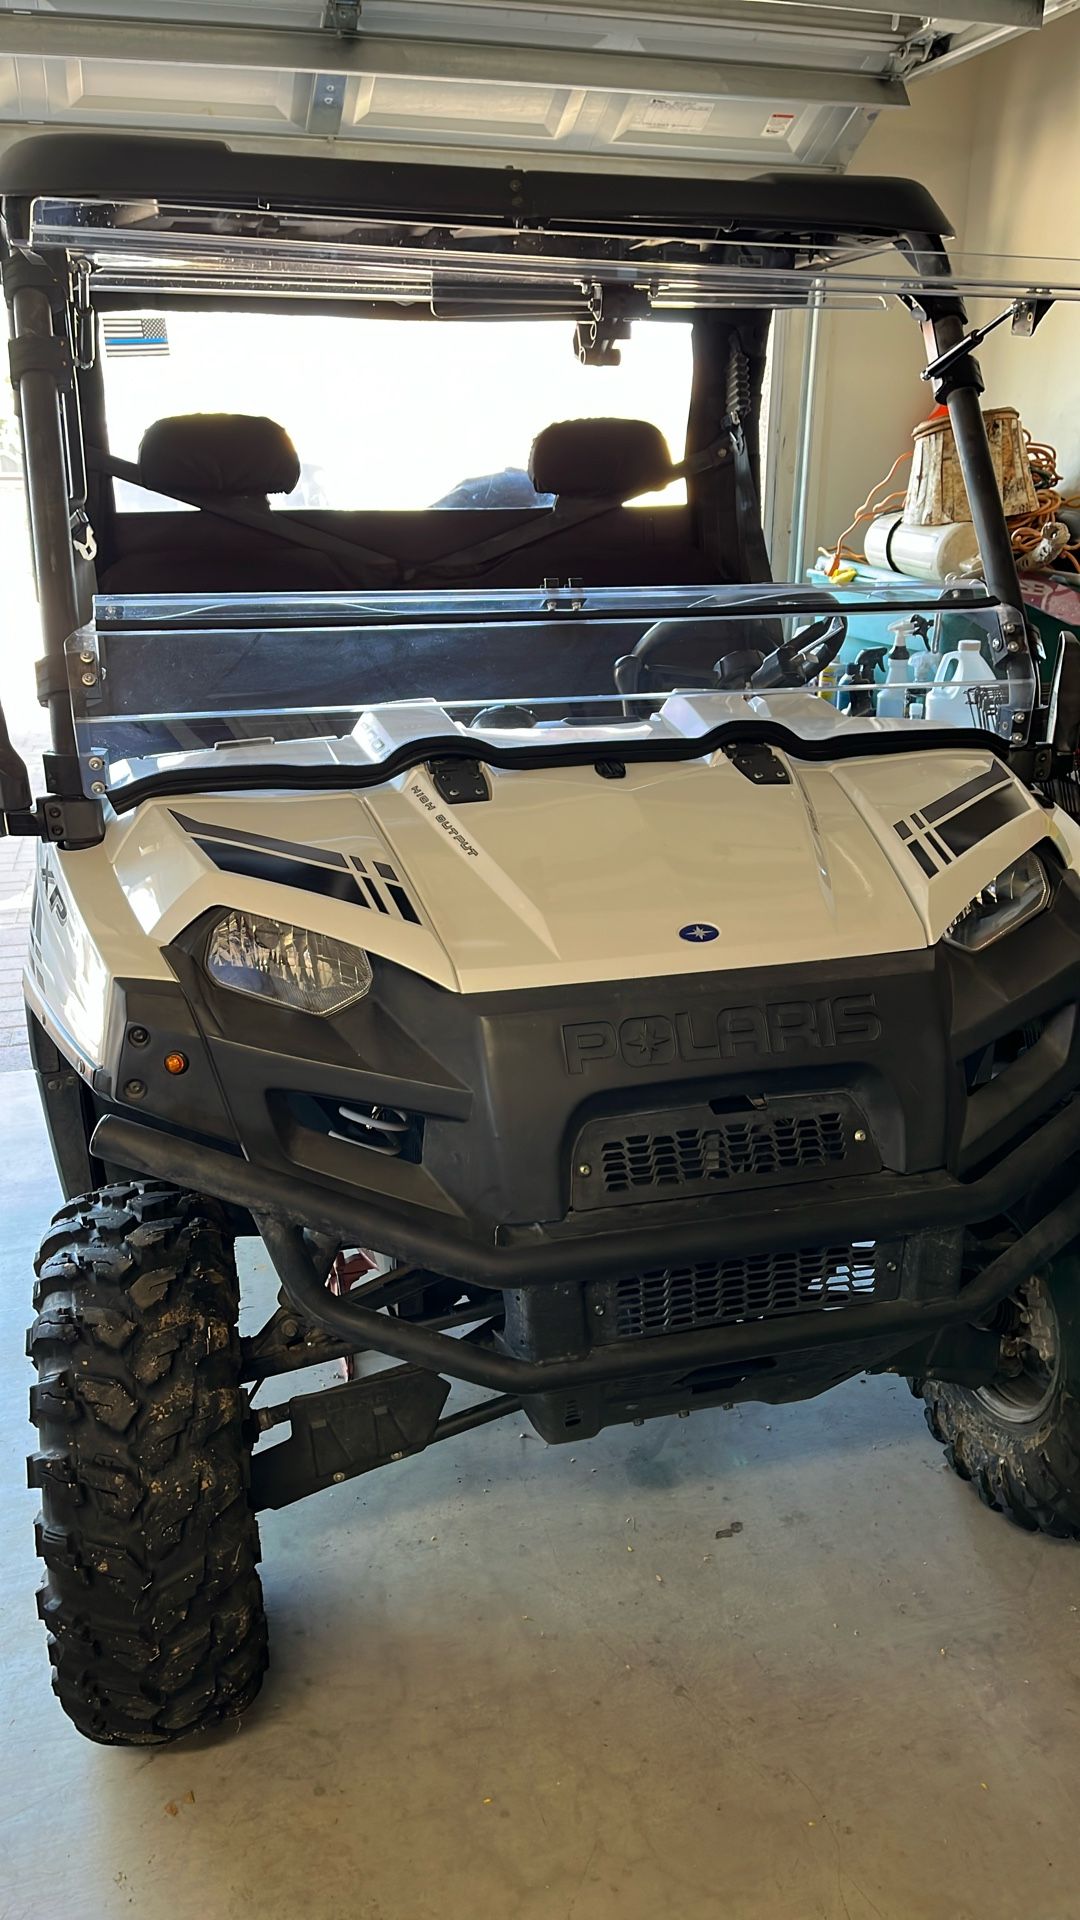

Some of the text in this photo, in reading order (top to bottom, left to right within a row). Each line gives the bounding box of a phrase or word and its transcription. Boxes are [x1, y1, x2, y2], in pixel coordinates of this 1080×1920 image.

[411, 785, 479, 857] HIGH OUTPUT
[41, 854, 68, 926] XP
[561, 993, 882, 1076] POLARIS
